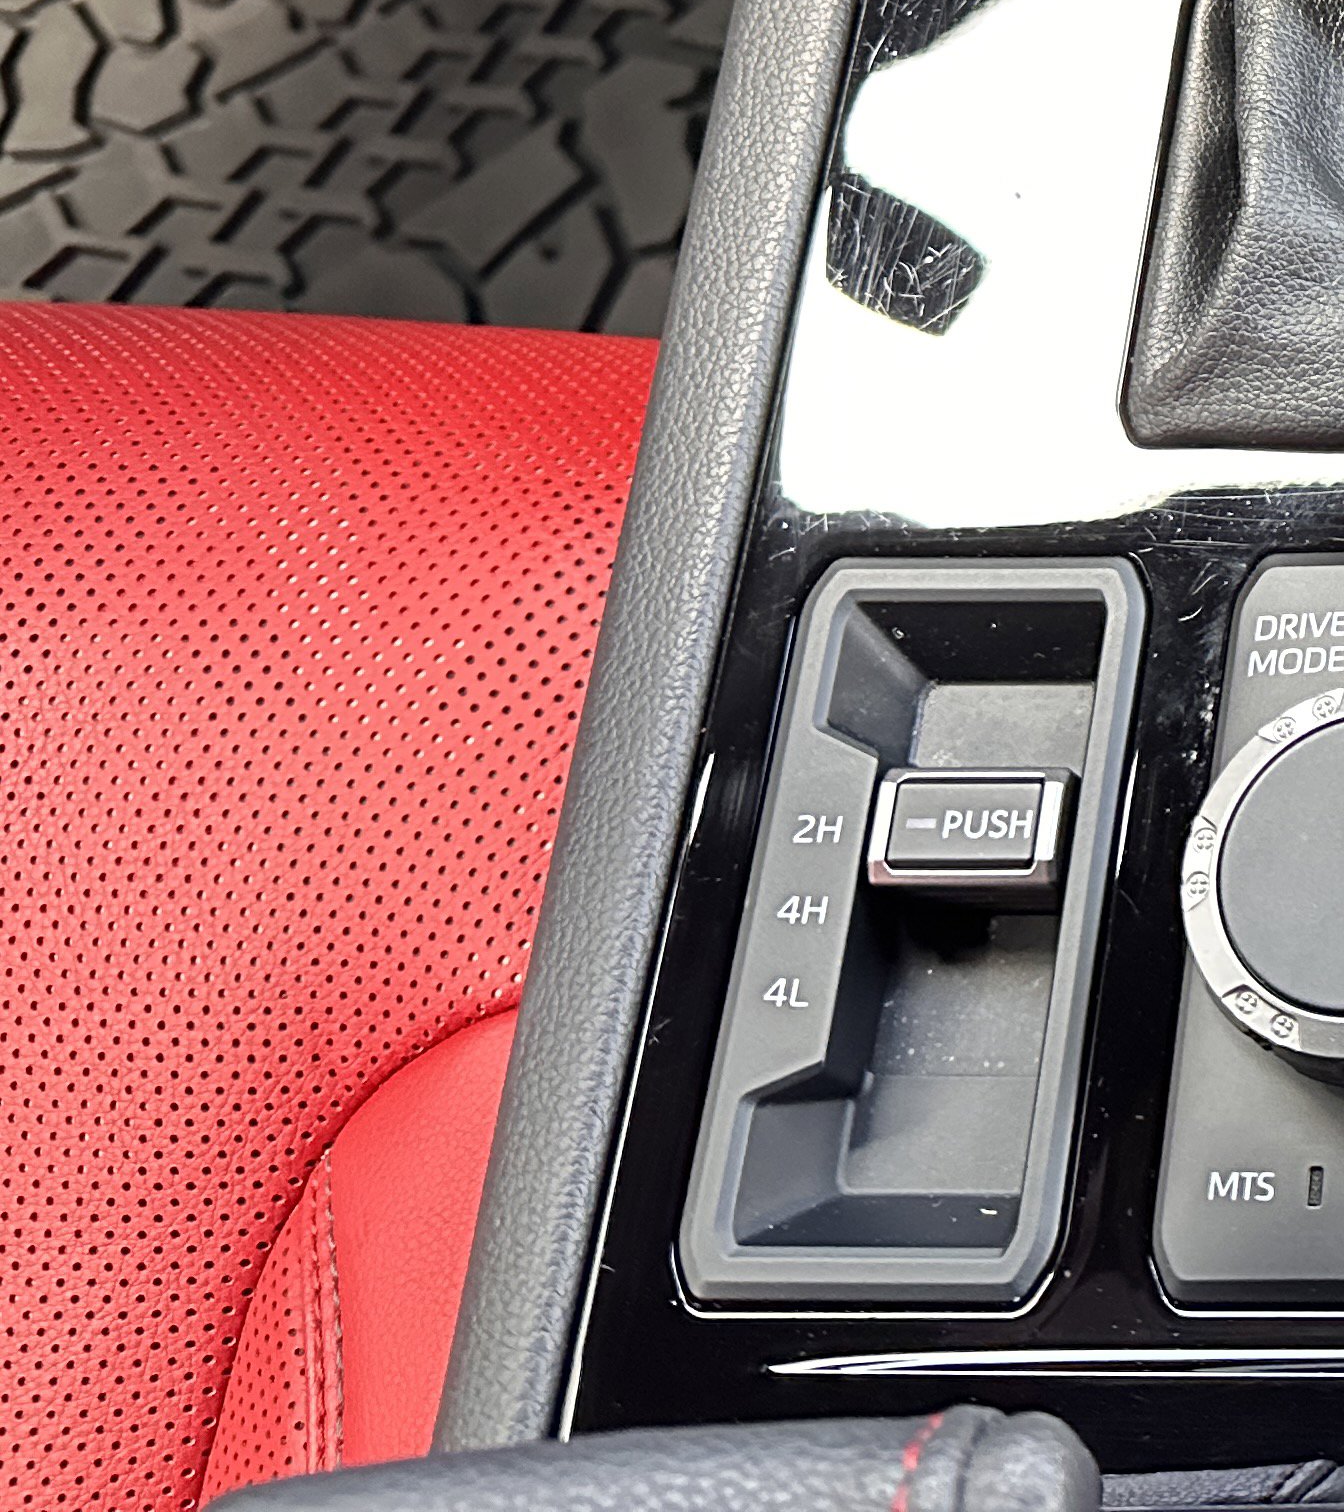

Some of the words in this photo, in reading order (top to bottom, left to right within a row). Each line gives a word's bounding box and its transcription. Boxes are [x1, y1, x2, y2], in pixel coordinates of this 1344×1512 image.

[792, 814, 844, 844] 2H
[941, 809, 1034, 840] PUSH
[776, 895, 829, 925] 4H
[763, 977, 809, 1008] 4L
[1207, 1171, 1276, 1202] MTS
